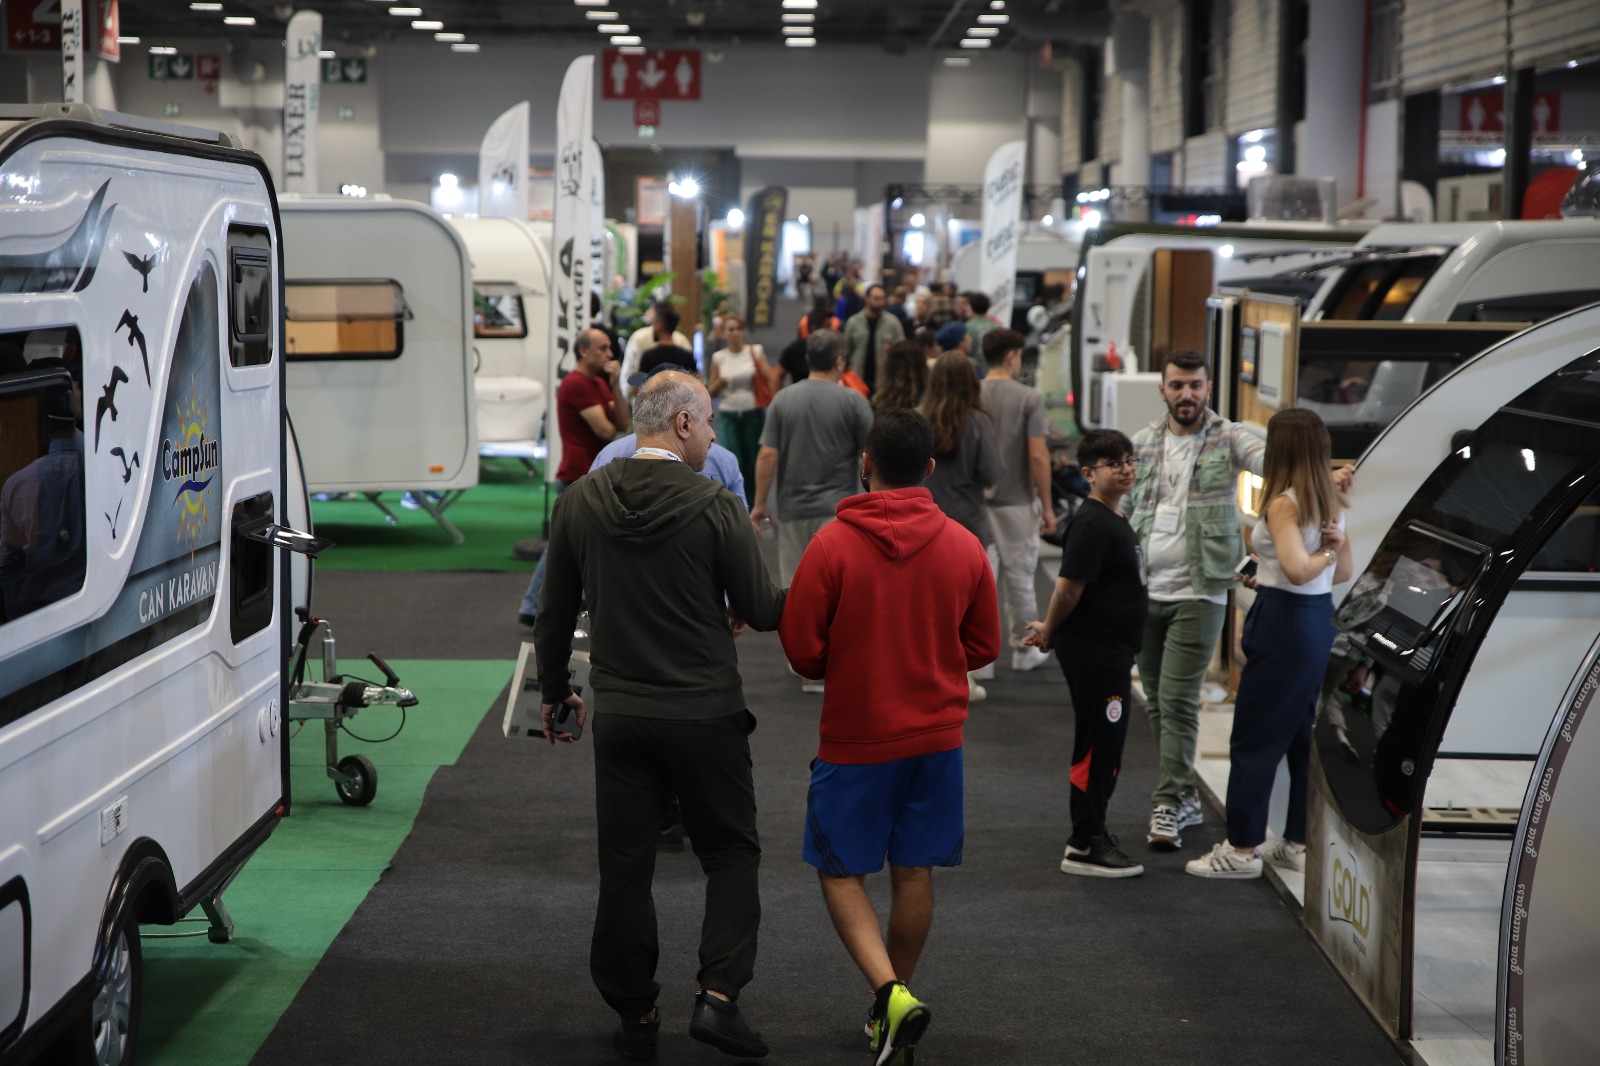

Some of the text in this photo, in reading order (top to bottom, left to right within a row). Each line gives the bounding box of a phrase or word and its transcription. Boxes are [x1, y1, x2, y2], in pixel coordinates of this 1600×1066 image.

[62, 8, 76, 102] XER
[287, 83, 305, 177] LUXER
[557, 236, 574, 388] NKA
[162, 431, 218, 482] CampSun
[139, 560, 216, 624] CAN KARAVAN
[1575, 660, 1600, 709] autogla
[1532, 767, 1554, 824] autoglass
[1333, 858, 1370, 940] GOLD
[1512, 883, 1527, 942] autoglass
[1508, 1007, 1523, 1066] autoglass
